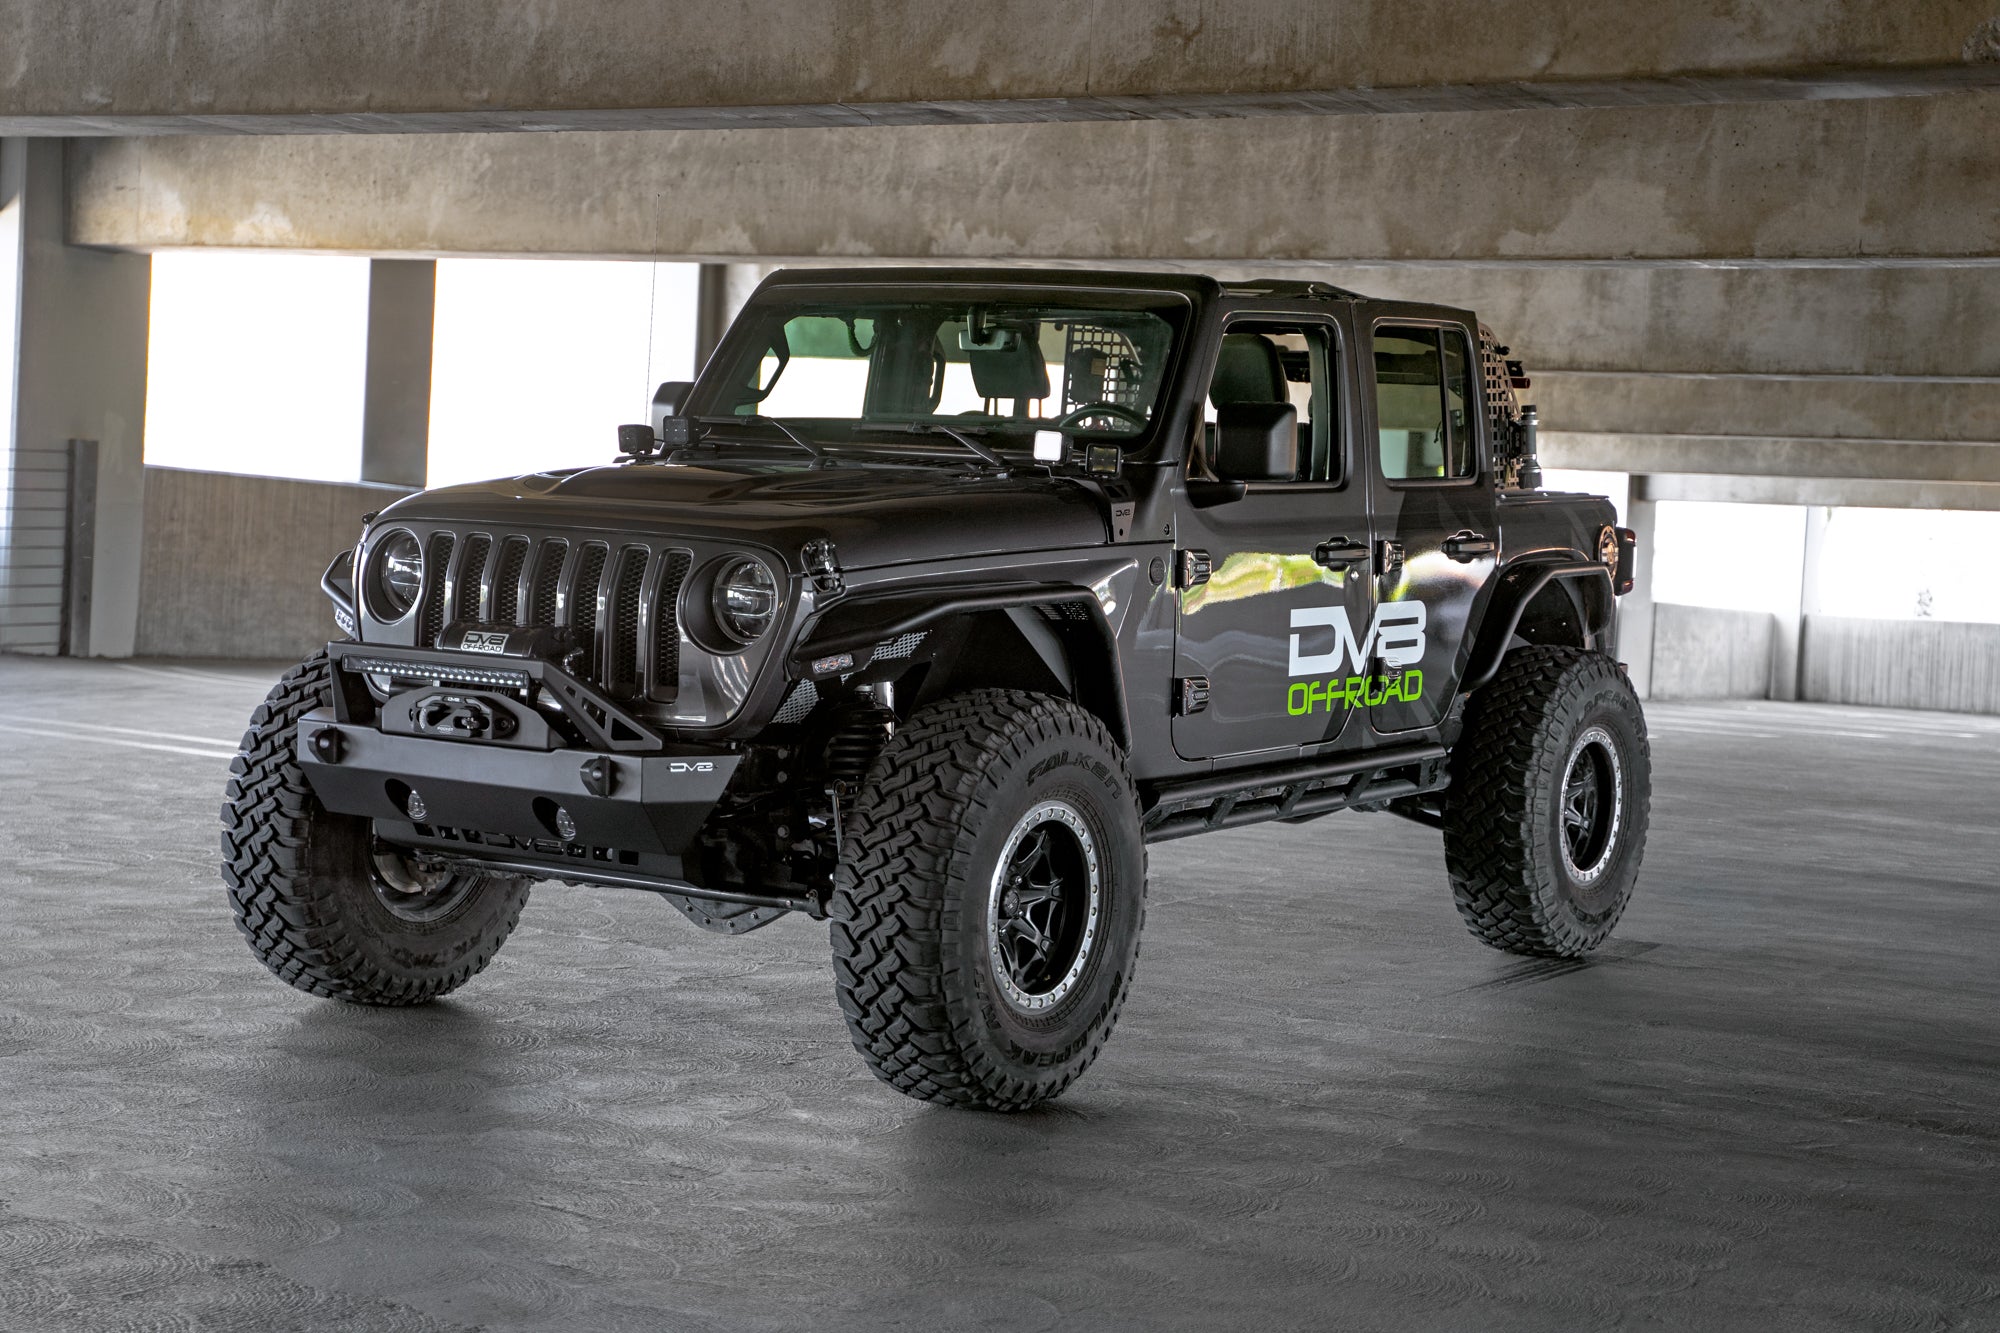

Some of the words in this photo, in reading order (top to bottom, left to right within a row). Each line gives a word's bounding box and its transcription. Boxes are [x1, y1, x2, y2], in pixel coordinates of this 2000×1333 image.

[464, 633, 506, 646] DV8
[1289, 600, 1427, 677] DV8
[1287, 669, 1423, 716] OFFROAD
[670, 762, 713, 772] DV8
